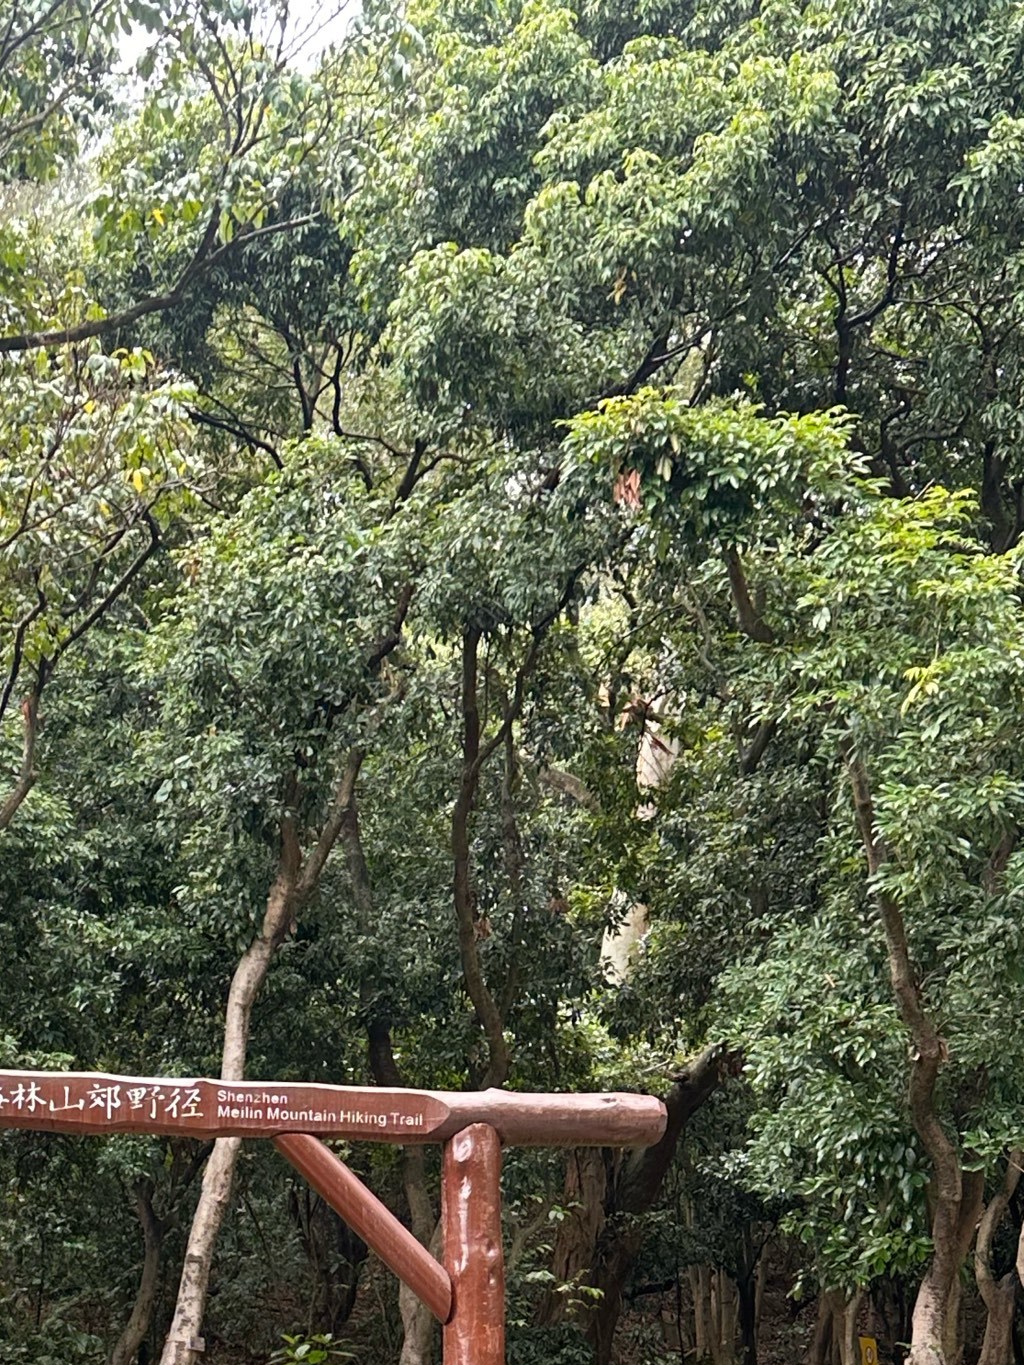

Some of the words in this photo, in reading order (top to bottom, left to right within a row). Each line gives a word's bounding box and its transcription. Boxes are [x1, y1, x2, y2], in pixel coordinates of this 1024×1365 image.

[217, 1089, 288, 1104] Shenzhen
[217, 1105, 263, 1120] Meilin
[266, 1107, 336, 1123] Mountain
[340, 1110, 387, 1127] Hiking
[390, 1112, 423, 1126] Trail
